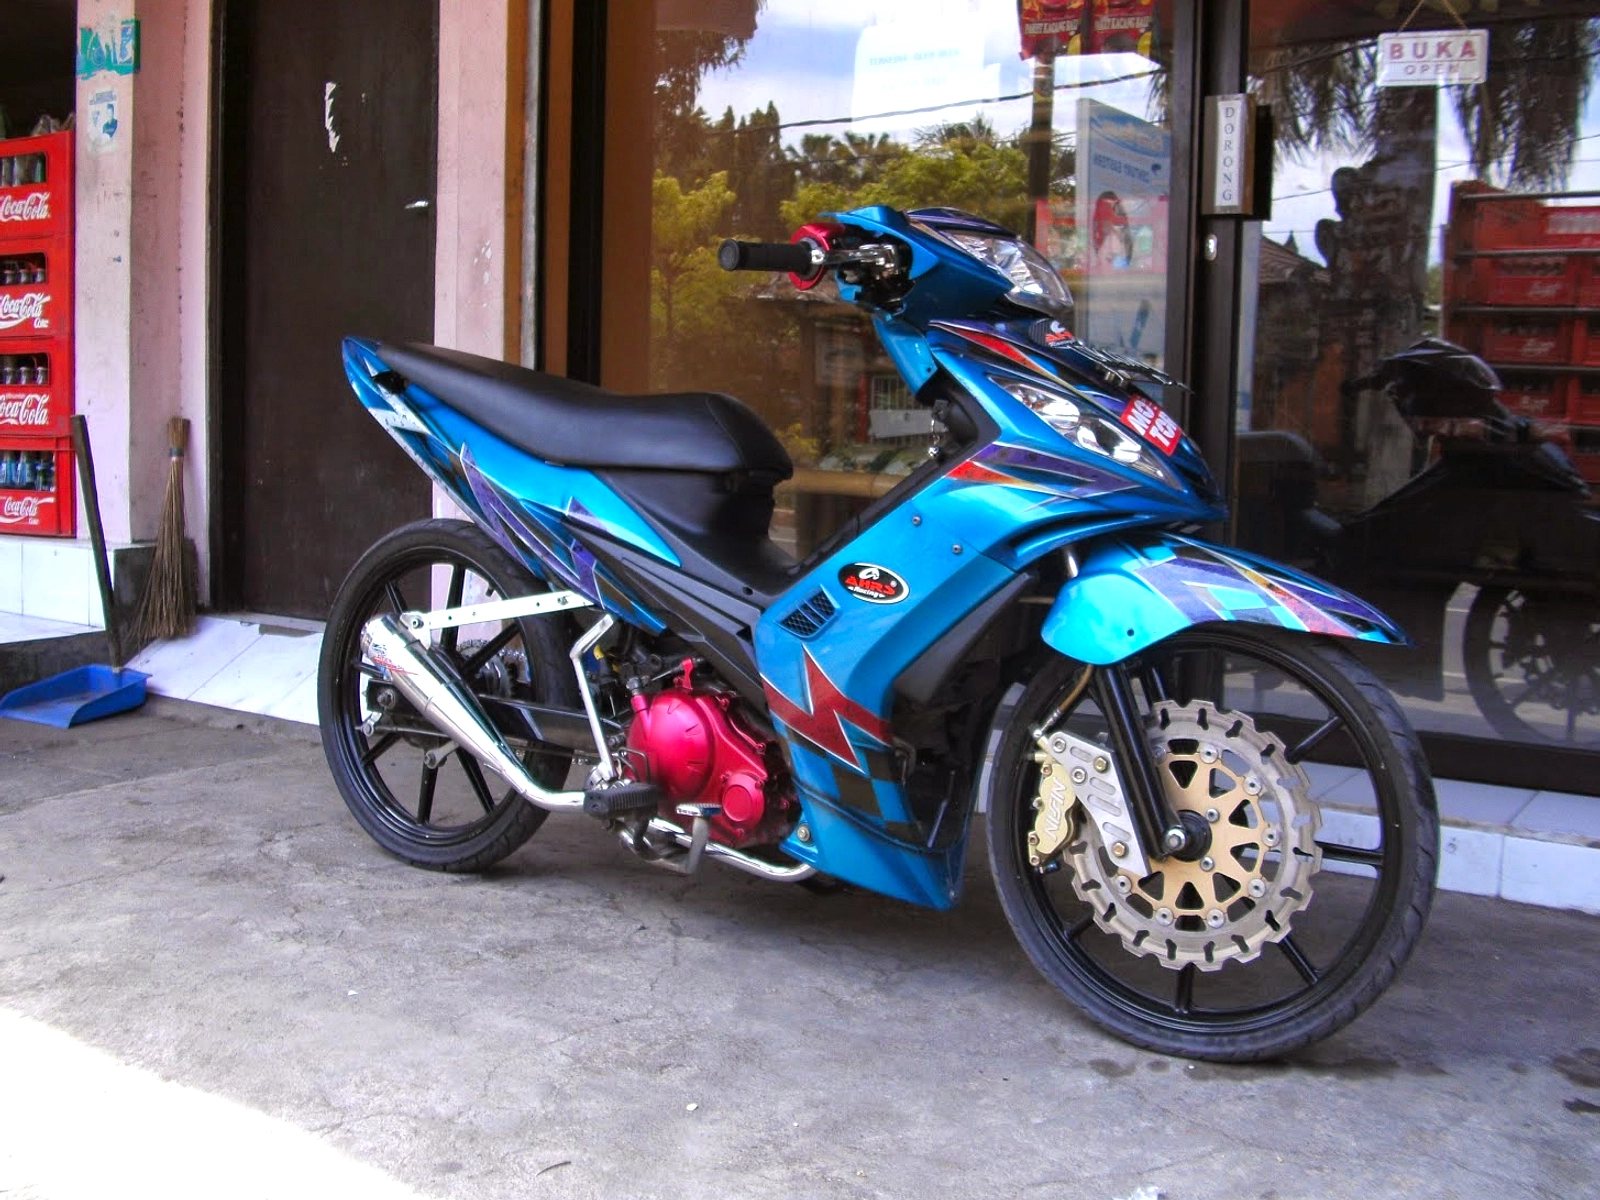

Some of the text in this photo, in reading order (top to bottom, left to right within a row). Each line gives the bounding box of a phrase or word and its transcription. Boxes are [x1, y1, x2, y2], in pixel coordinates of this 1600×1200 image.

[1389, 40, 1477, 59] BUKA
[1404, 63, 1459, 75] OPEN
[1222, 106, 1236, 201] DORONG
